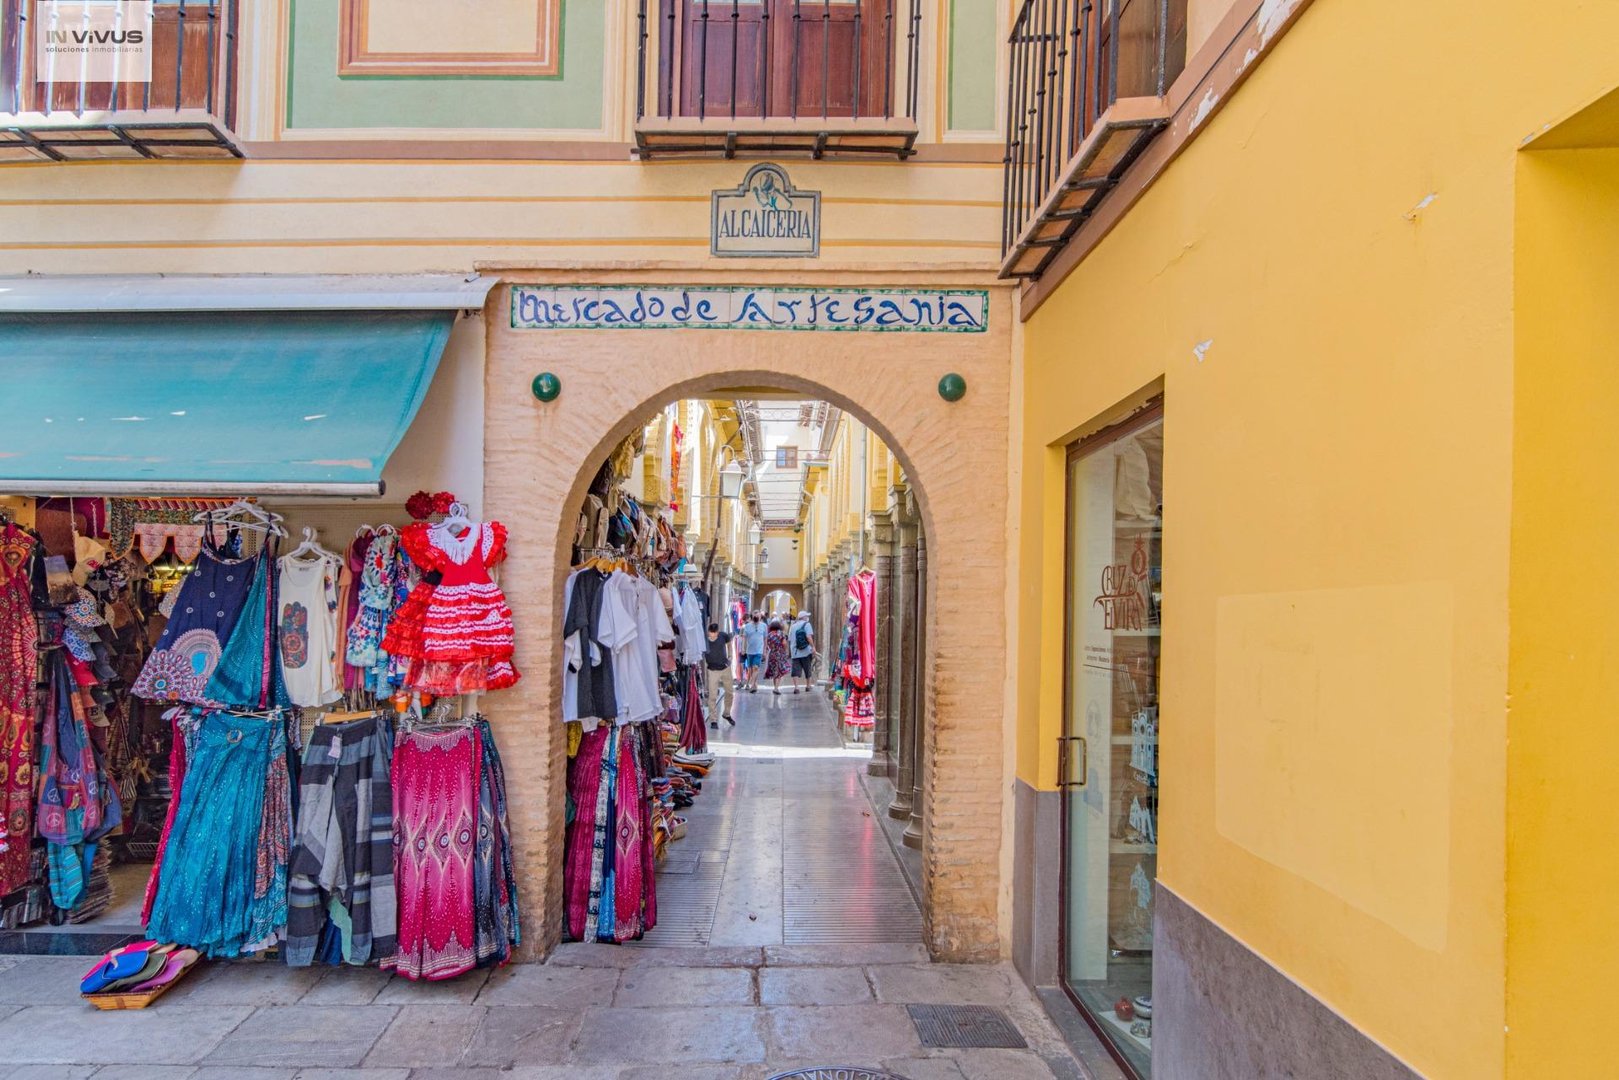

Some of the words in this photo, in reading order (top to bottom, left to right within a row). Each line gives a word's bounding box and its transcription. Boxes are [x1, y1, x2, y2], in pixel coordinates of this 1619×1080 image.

[718, 209, 812, 238] ALCAICERIA
[671, 290, 718, 322] de
[1102, 566, 1127, 596] CRUZ
